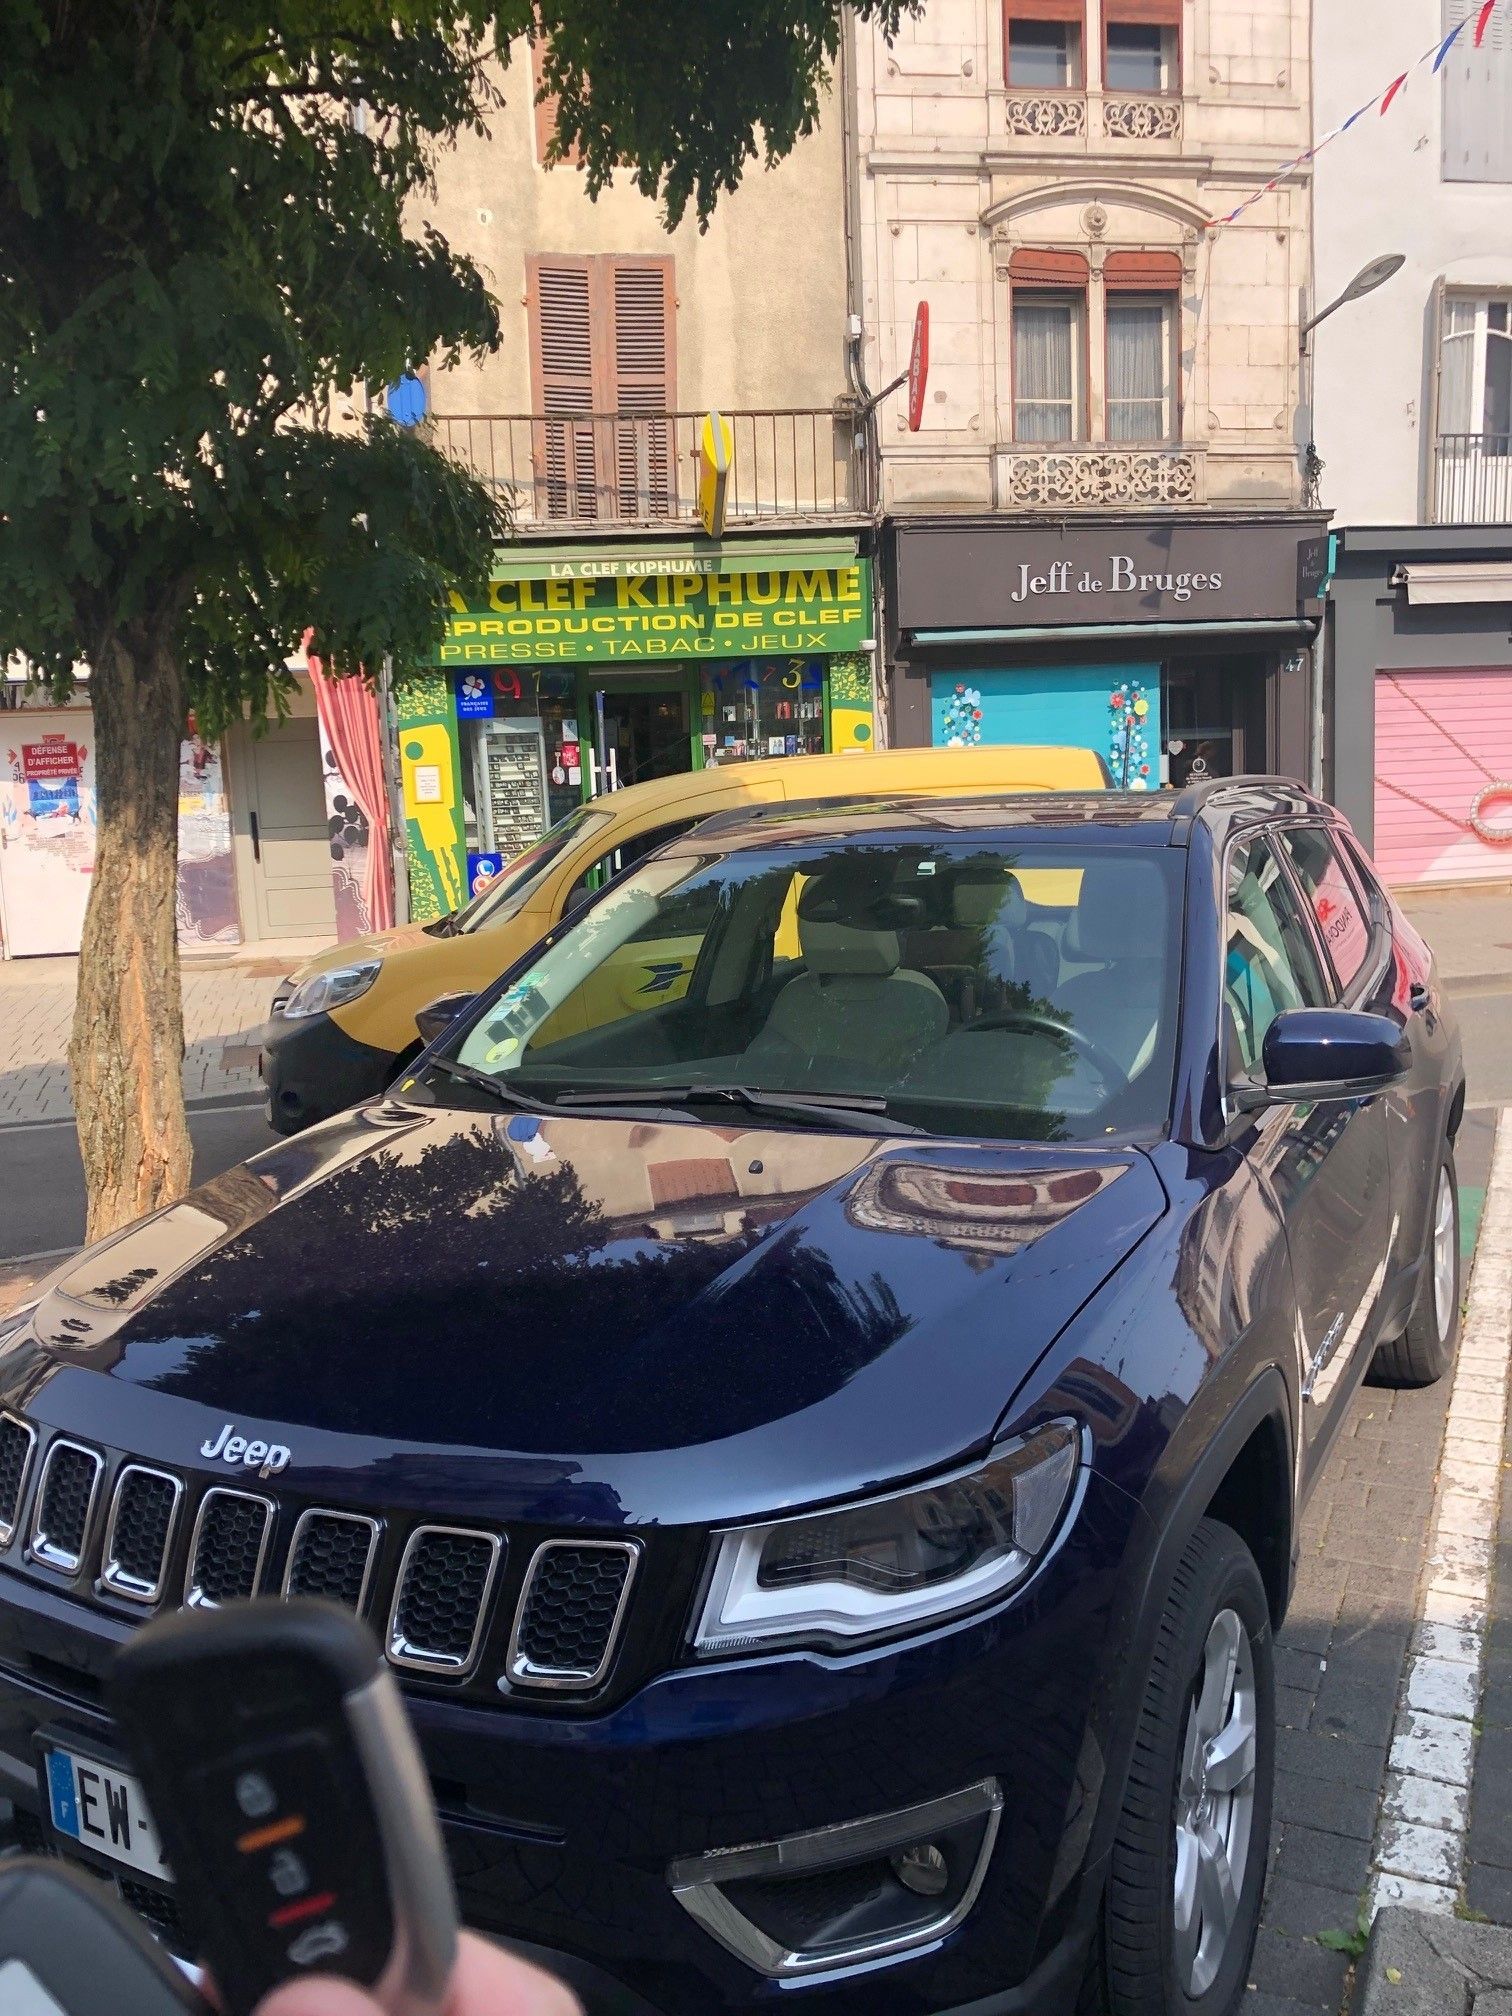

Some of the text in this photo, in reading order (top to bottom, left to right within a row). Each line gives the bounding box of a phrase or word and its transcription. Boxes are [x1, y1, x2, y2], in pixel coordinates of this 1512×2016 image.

[911, 320, 922, 414] TABAC
[550, 559, 713, 577] LA CLEF KIPHUME
[1011, 555, 1222, 602] Jeff de Bruges
[488, 576, 597, 613] CLEF
[616, 565, 861, 609] KIPHUME
[444, 608, 862, 637] PRODUCTION DE CLEF
[440, 632, 827, 660] PRESSE TABAC JEUX
[1285, 658, 1304, 671] 47
[27, 756, 74, 766] D'AFFICHER
[200, 1424, 291, 1479] Jeep
